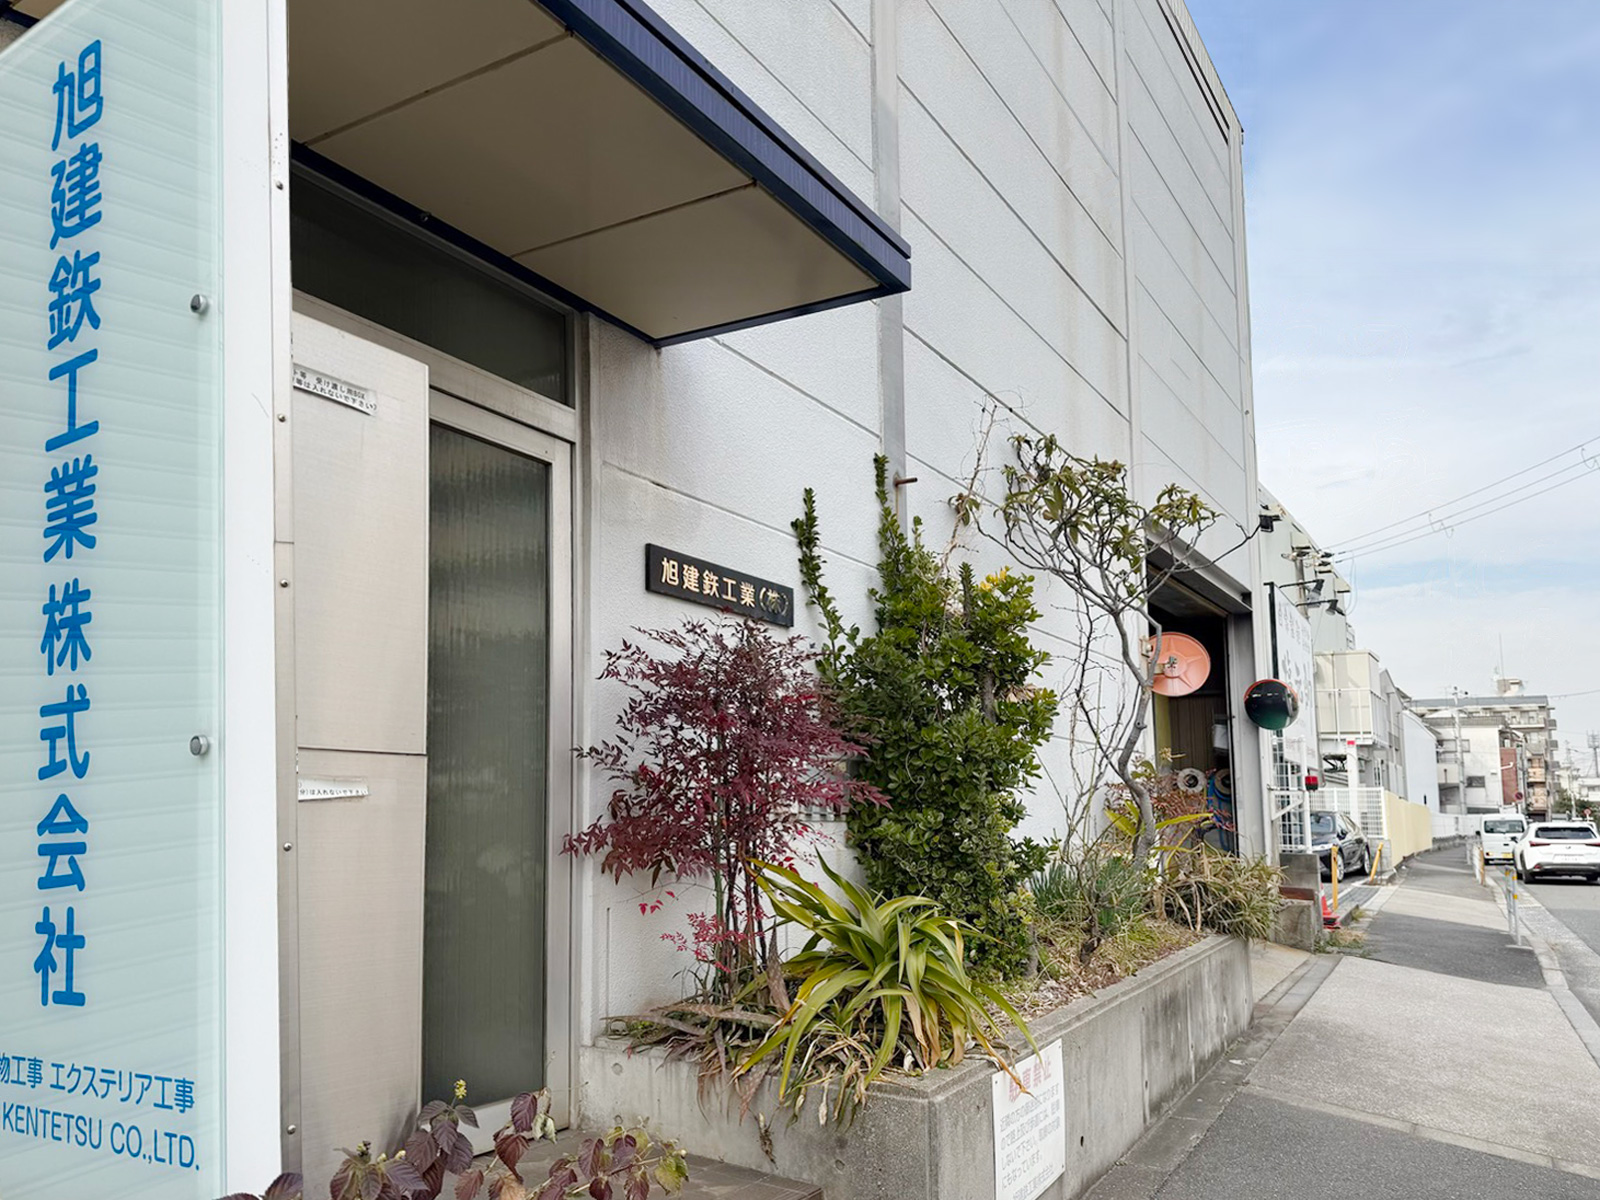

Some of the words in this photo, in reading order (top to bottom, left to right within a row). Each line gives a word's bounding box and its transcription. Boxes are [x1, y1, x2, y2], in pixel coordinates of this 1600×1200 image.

[34, 38, 104, 1008] 旭建鉄工業株式会社
[50, 1062, 196, 1114] エクステリア工事
[3, 1101, 103, 1150] KENTETSU
[110, 1121, 200, 1171] CO.,LTD.
